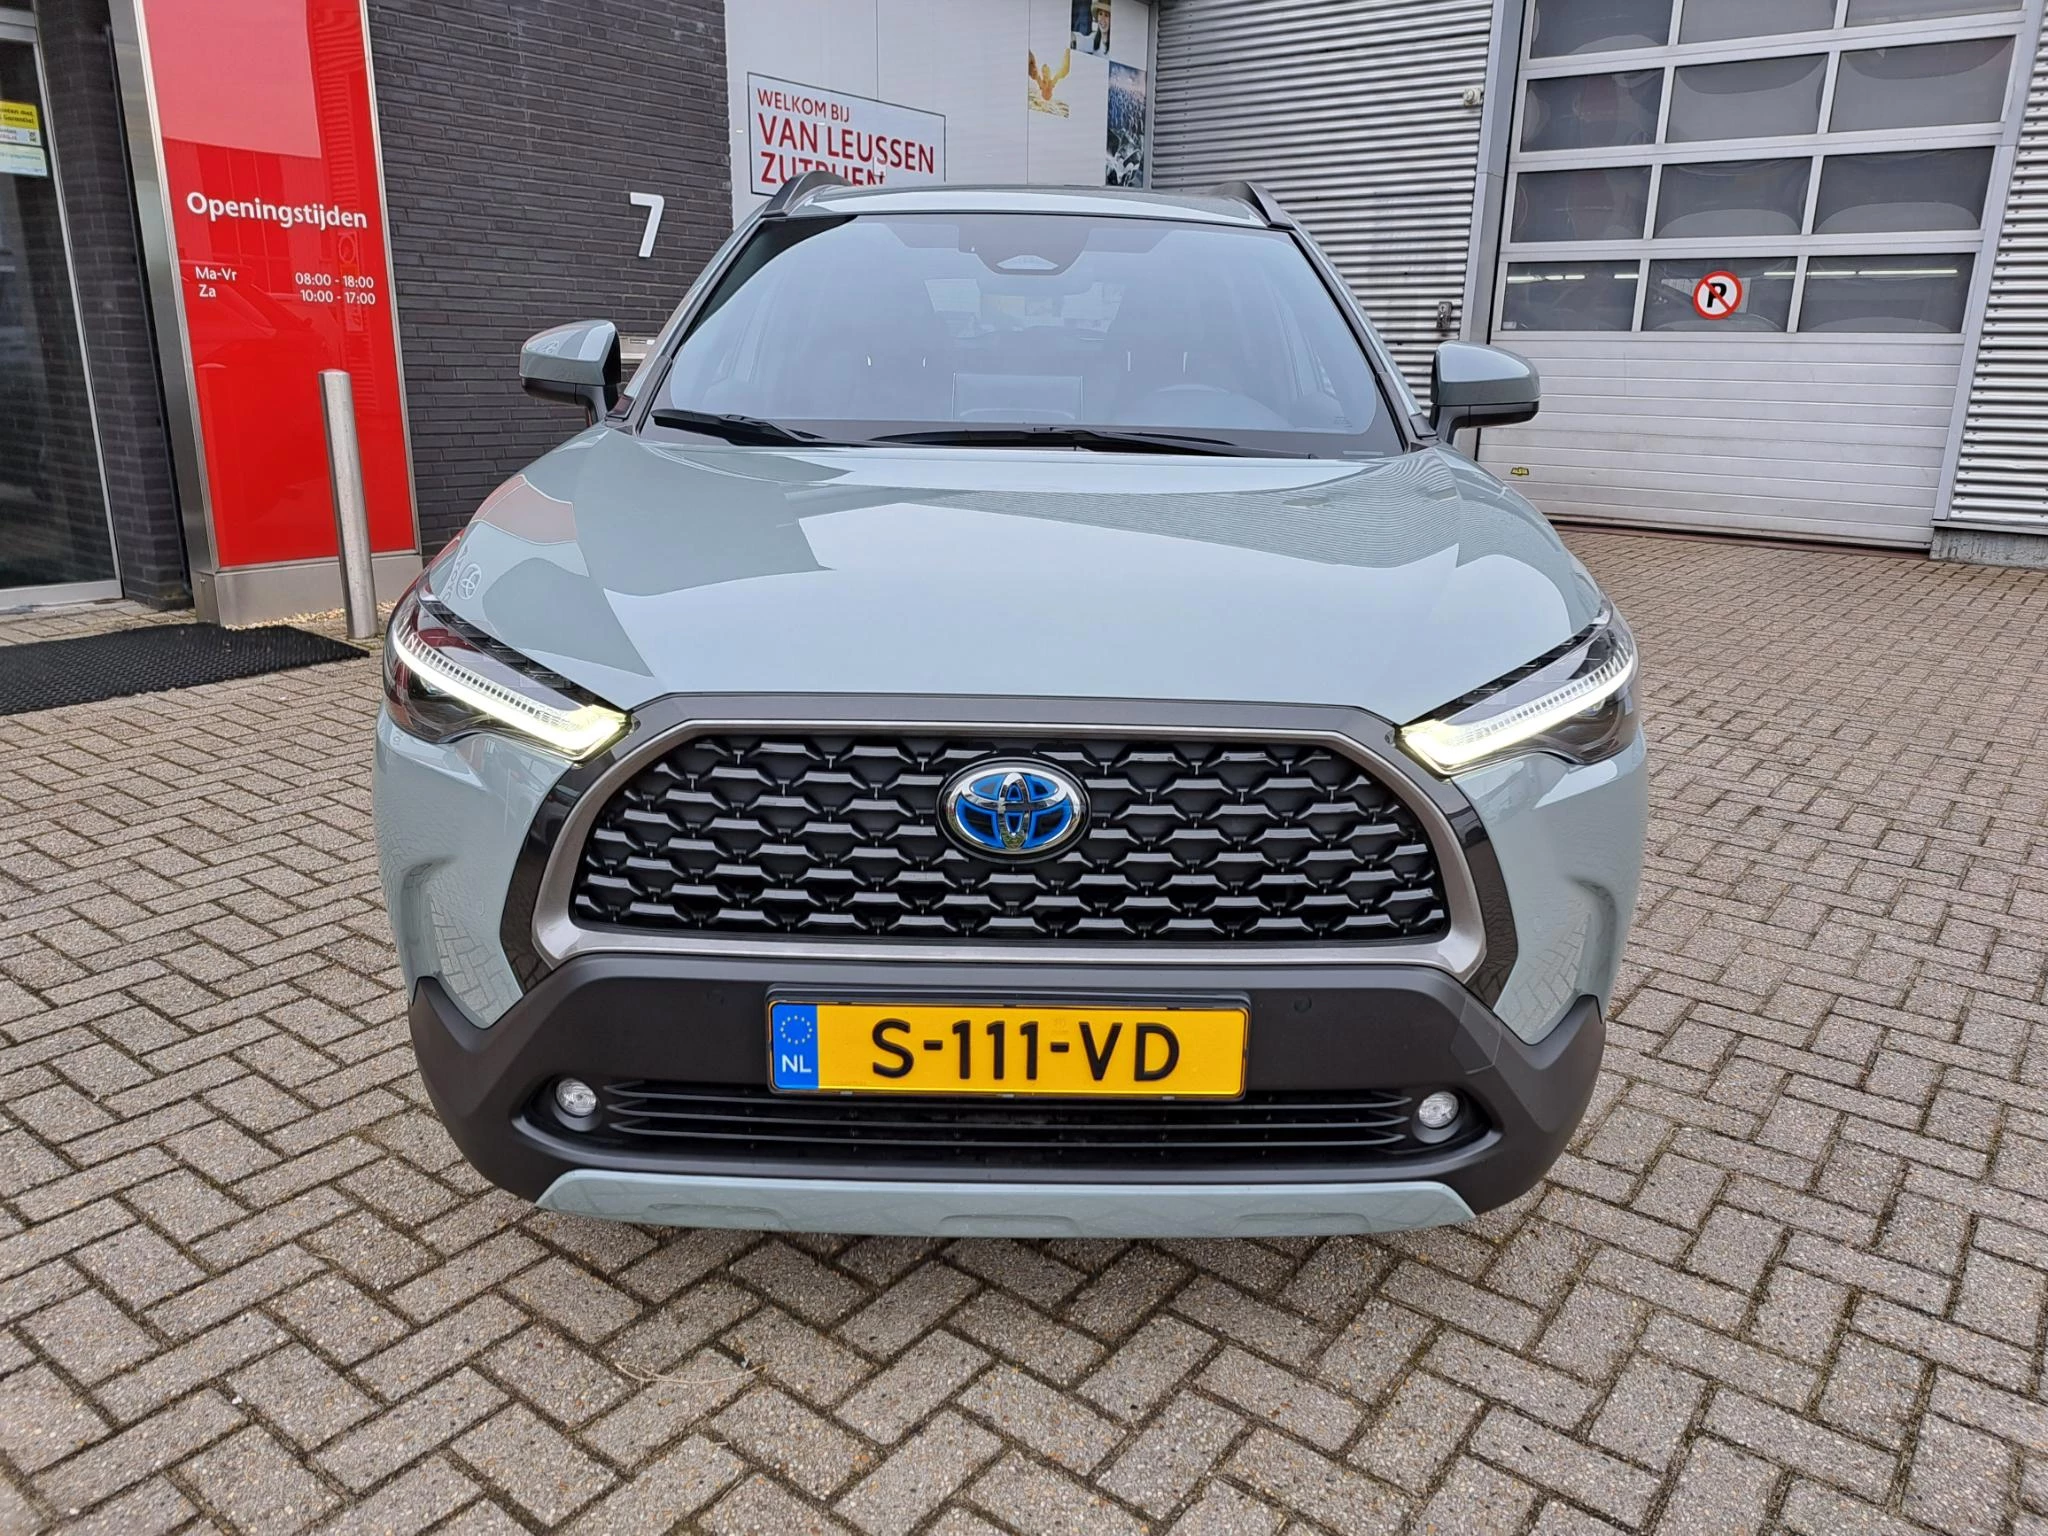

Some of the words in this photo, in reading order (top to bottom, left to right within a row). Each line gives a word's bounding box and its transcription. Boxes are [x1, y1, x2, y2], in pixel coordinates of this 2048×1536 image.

[757, 87, 827, 119] WELKOM
[831, 103, 850, 123] BIJ
[758, 112, 818, 154] VAN
[827, 126, 935, 175] LEUSSEN
[186, 191, 368, 231] Openingstijden
[629, 191, 665, 258] 7
[195, 266, 238, 282] Ma-Vr
[295, 272, 332, 287] 08:00
[342, 275, 374, 289] 18:00
[198, 283, 217, 299] Za
[301, 289, 334, 303] 10:00
[344, 291, 376, 305] 17:00
[1706, 282, 1727, 308] P
[781, 1054, 812, 1074] NL
[871, 1018, 1180, 1082] S-111-VD
